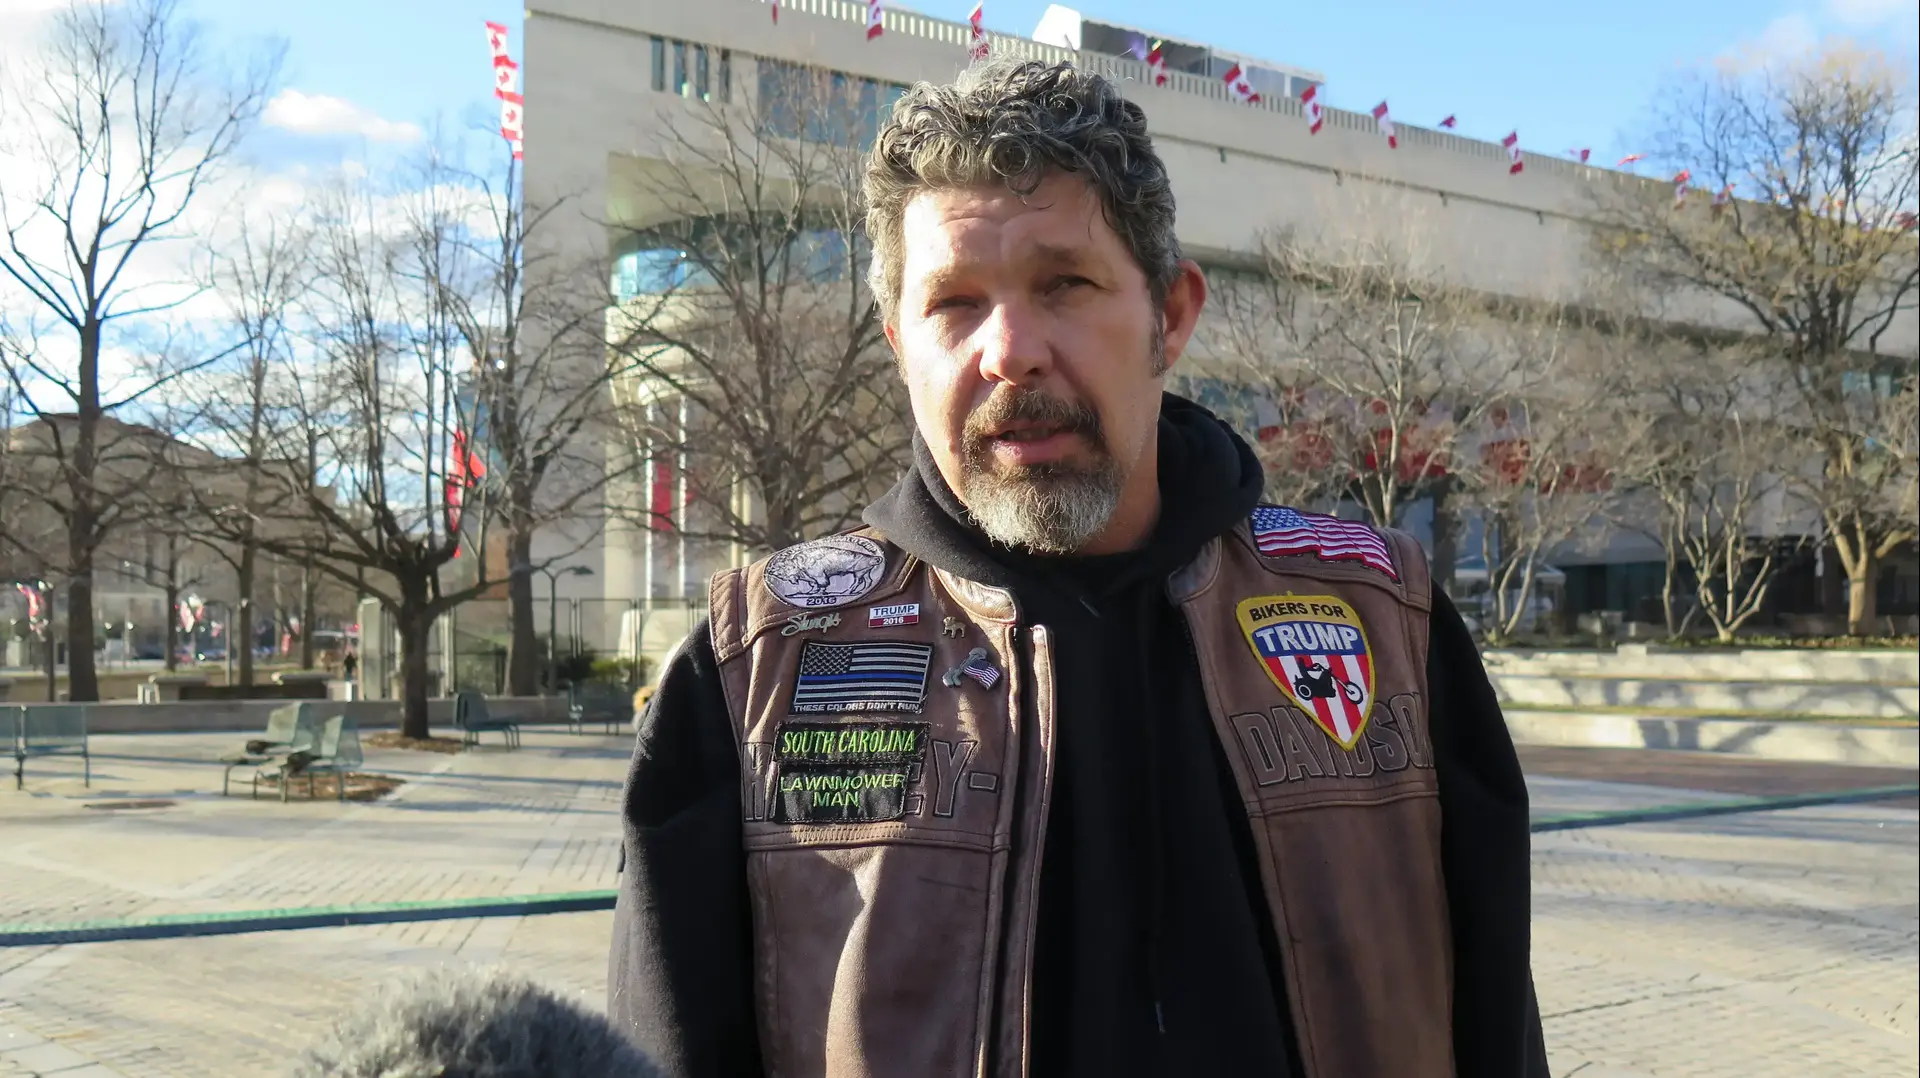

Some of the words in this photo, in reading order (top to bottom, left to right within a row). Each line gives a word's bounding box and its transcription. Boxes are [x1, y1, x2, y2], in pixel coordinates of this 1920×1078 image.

[807, 597, 837, 606] 2016
[873, 605, 915, 616] TRUMP
[1249, 602, 1309, 622] BIKERS
[1311, 603, 1348, 619] FOR
[781, 612, 841, 636] Sturgis
[883, 617, 904, 625] 2016
[1255, 623, 1359, 652] TRUMP
[794, 704, 825, 712] THESE
[827, 702, 865, 712] COLORS
[866, 702, 896, 711] DON'T
[782, 730, 834, 753] SOUTH
[837, 730, 917, 753] CAROLINA
[780, 773, 906, 792] LAWNMOWER
[813, 791, 860, 807] MAN
